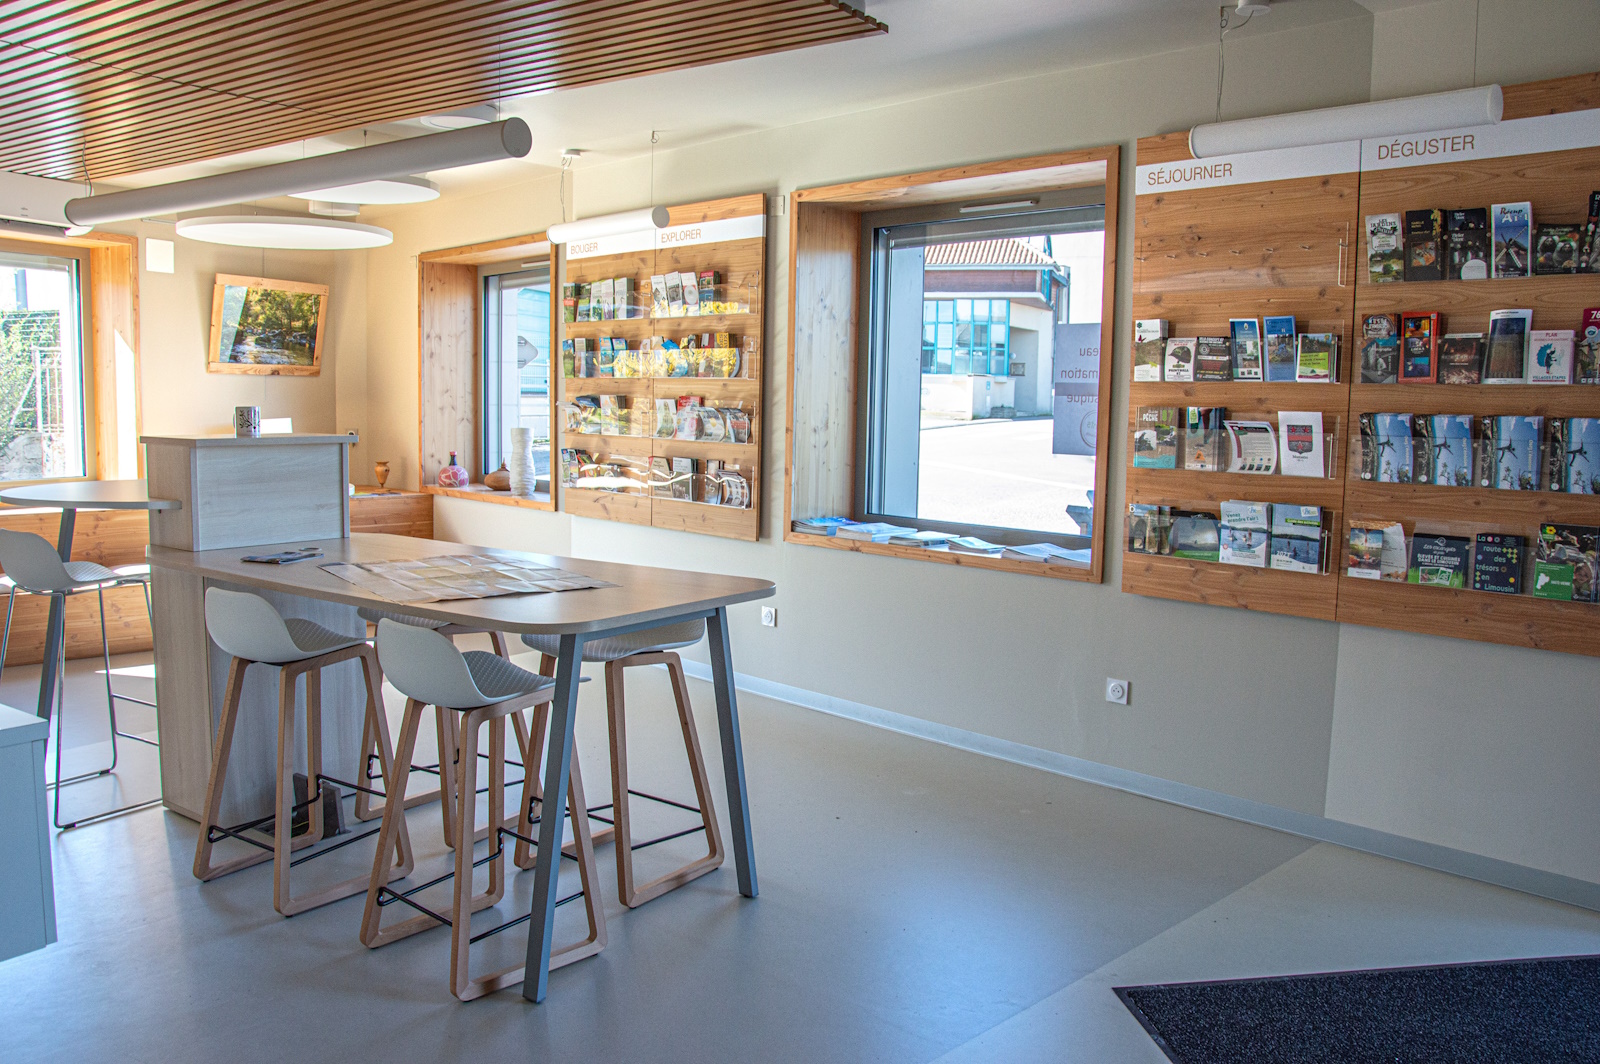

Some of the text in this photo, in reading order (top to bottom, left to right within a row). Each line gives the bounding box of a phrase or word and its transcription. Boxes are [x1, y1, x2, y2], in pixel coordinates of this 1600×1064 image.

[1377, 134, 1475, 160] DÉGUSTER
[1147, 162, 1233, 186] SÉJOURNER
[661, 228, 702, 243] EXPLORER
[570, 242, 599, 255] BOUGER
[1483, 545, 1502, 553] route
[1493, 554, 1507, 563] des
[1476, 563, 1500, 572] trésors
[1484, 583, 1515, 593] Limousin
